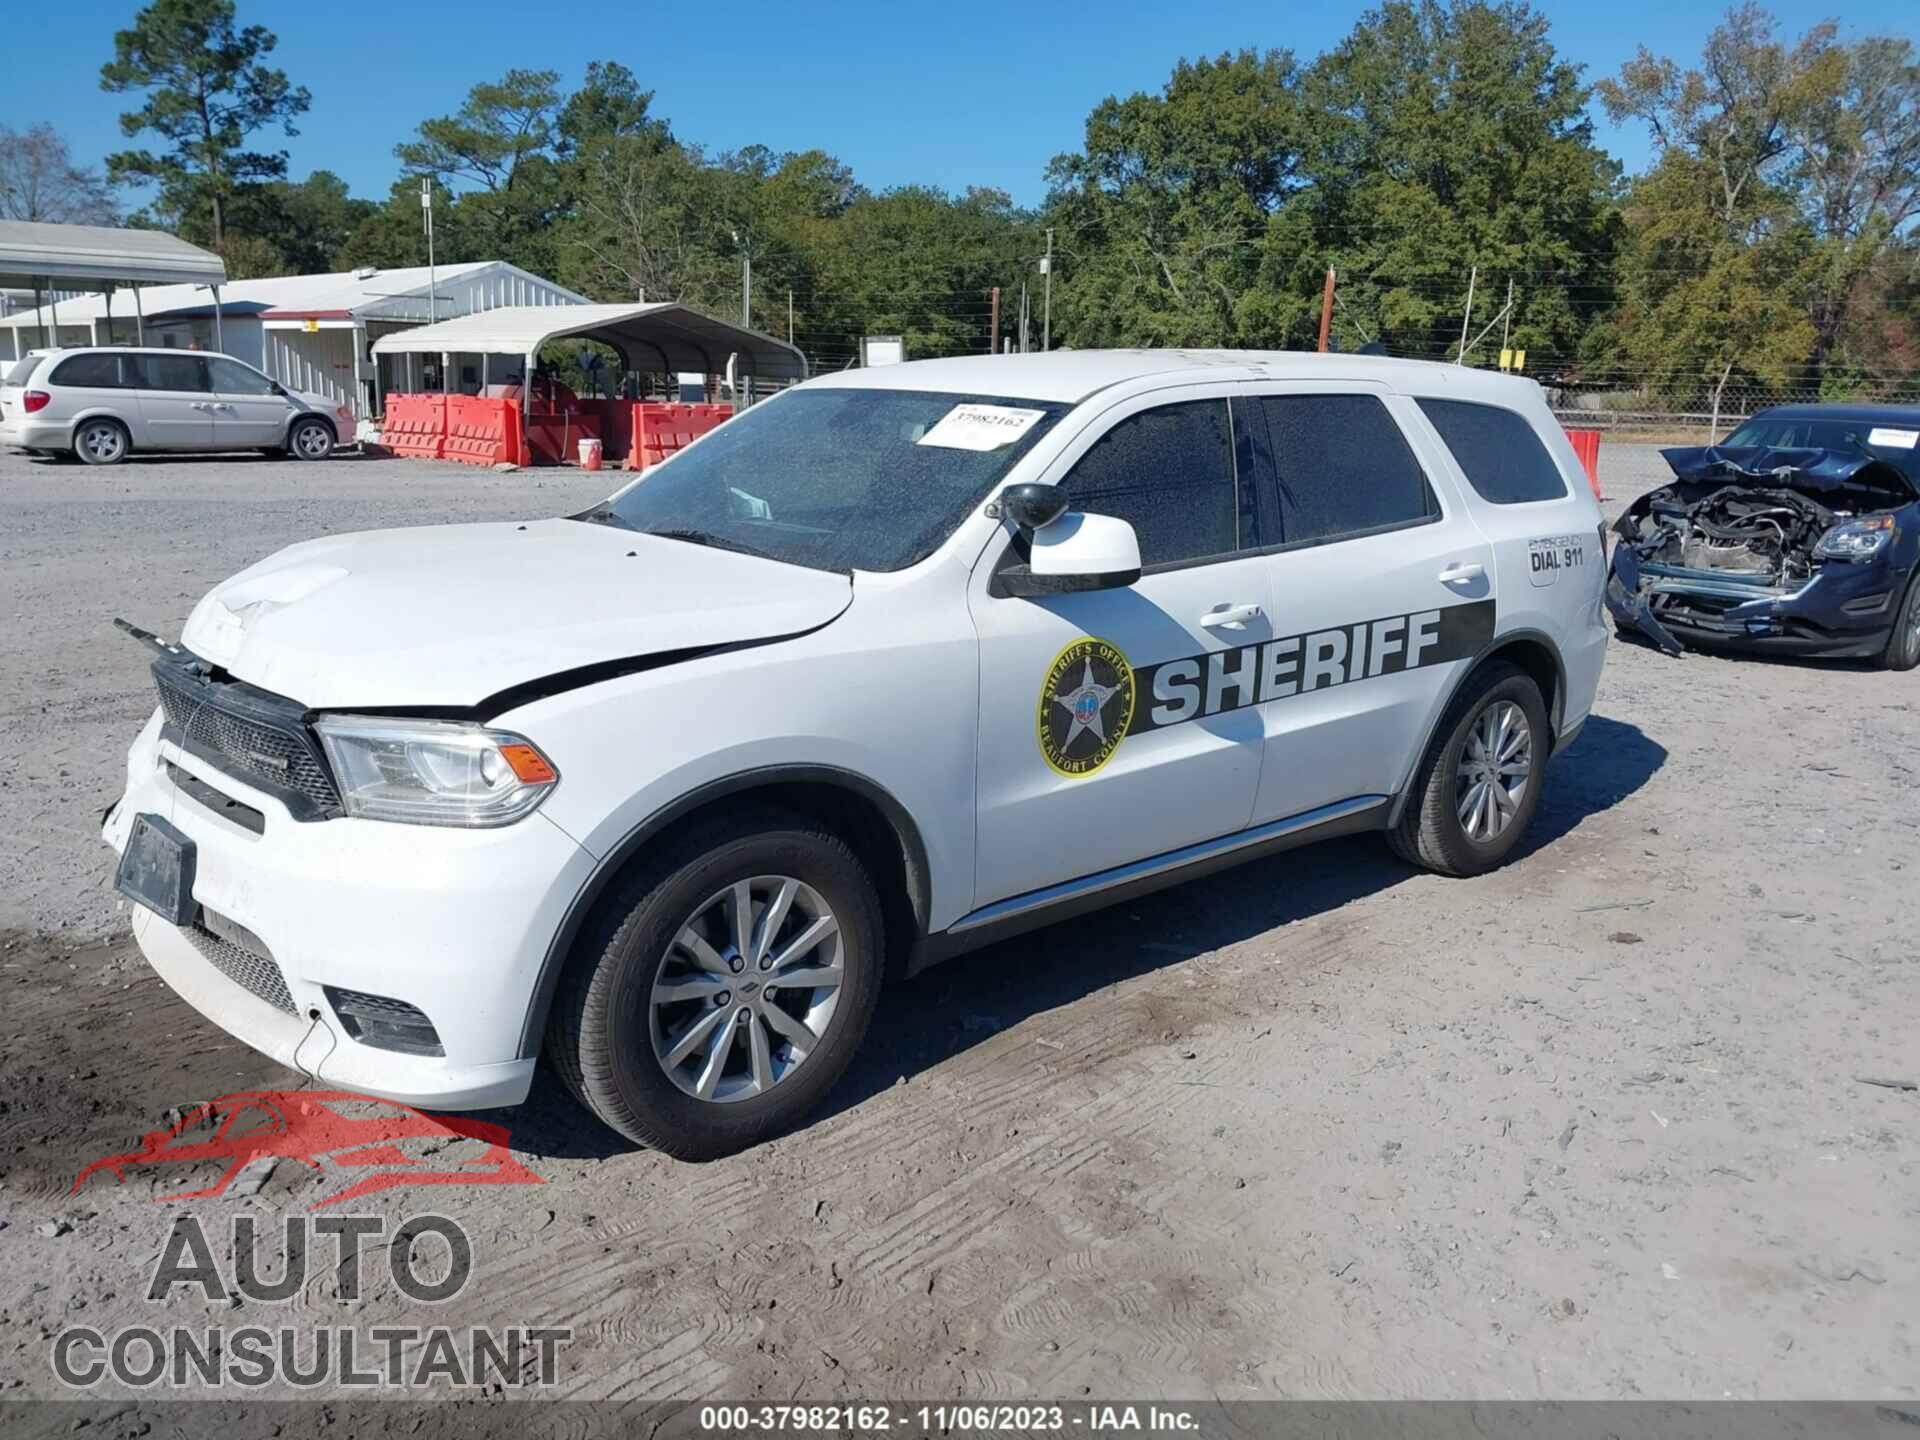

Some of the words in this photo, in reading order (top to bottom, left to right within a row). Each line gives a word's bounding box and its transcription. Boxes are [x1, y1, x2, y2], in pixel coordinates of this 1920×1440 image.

[1531, 550, 1560, 572] DIAL
[1564, 547, 1583, 568] 911
[1046, 643, 1093, 700] SHERIFF'S
[1100, 645, 1130, 686] OFFICE
[1151, 610, 1441, 727] SHERIFF
[1041, 724, 1087, 772] BEAUFORT
[1094, 711, 1129, 765] COUNTY
